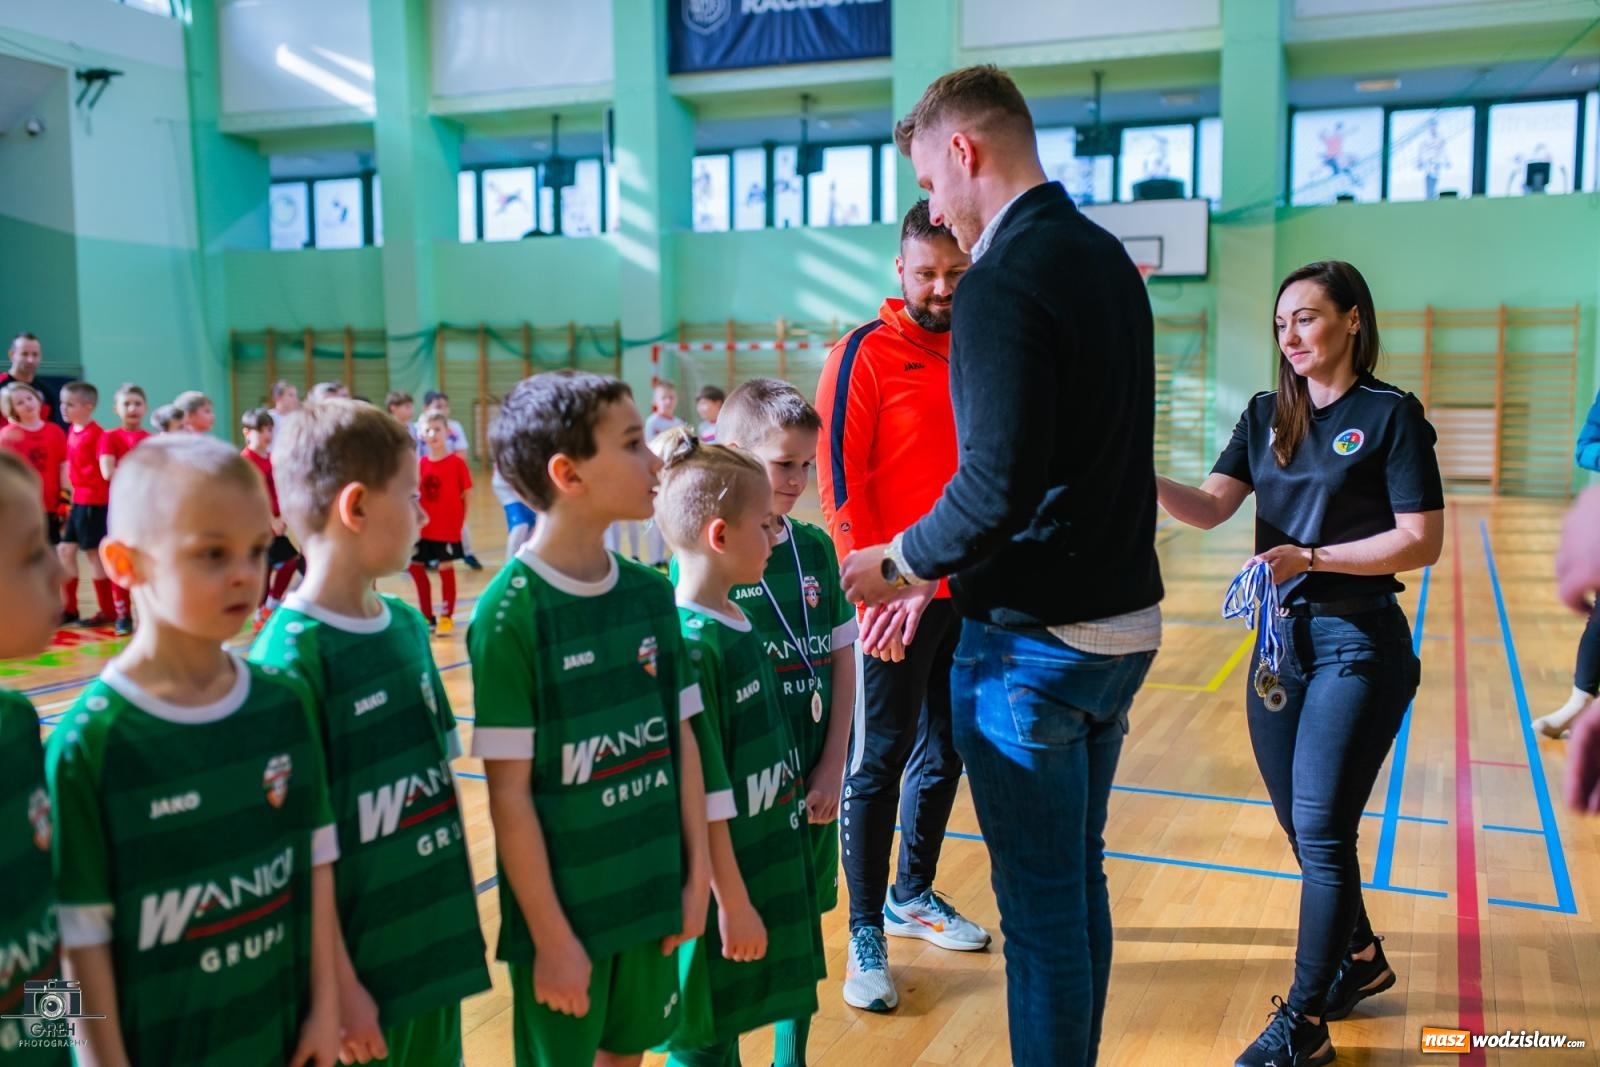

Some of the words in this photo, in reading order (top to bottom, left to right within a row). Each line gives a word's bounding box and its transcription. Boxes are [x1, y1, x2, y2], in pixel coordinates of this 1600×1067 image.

[735, 586, 764, 600] JAKO
[735, 680, 761, 704] JAKO
[783, 677, 823, 696] RUPA
[353, 690, 388, 716] JAKO
[150, 791, 201, 819] JAKO
